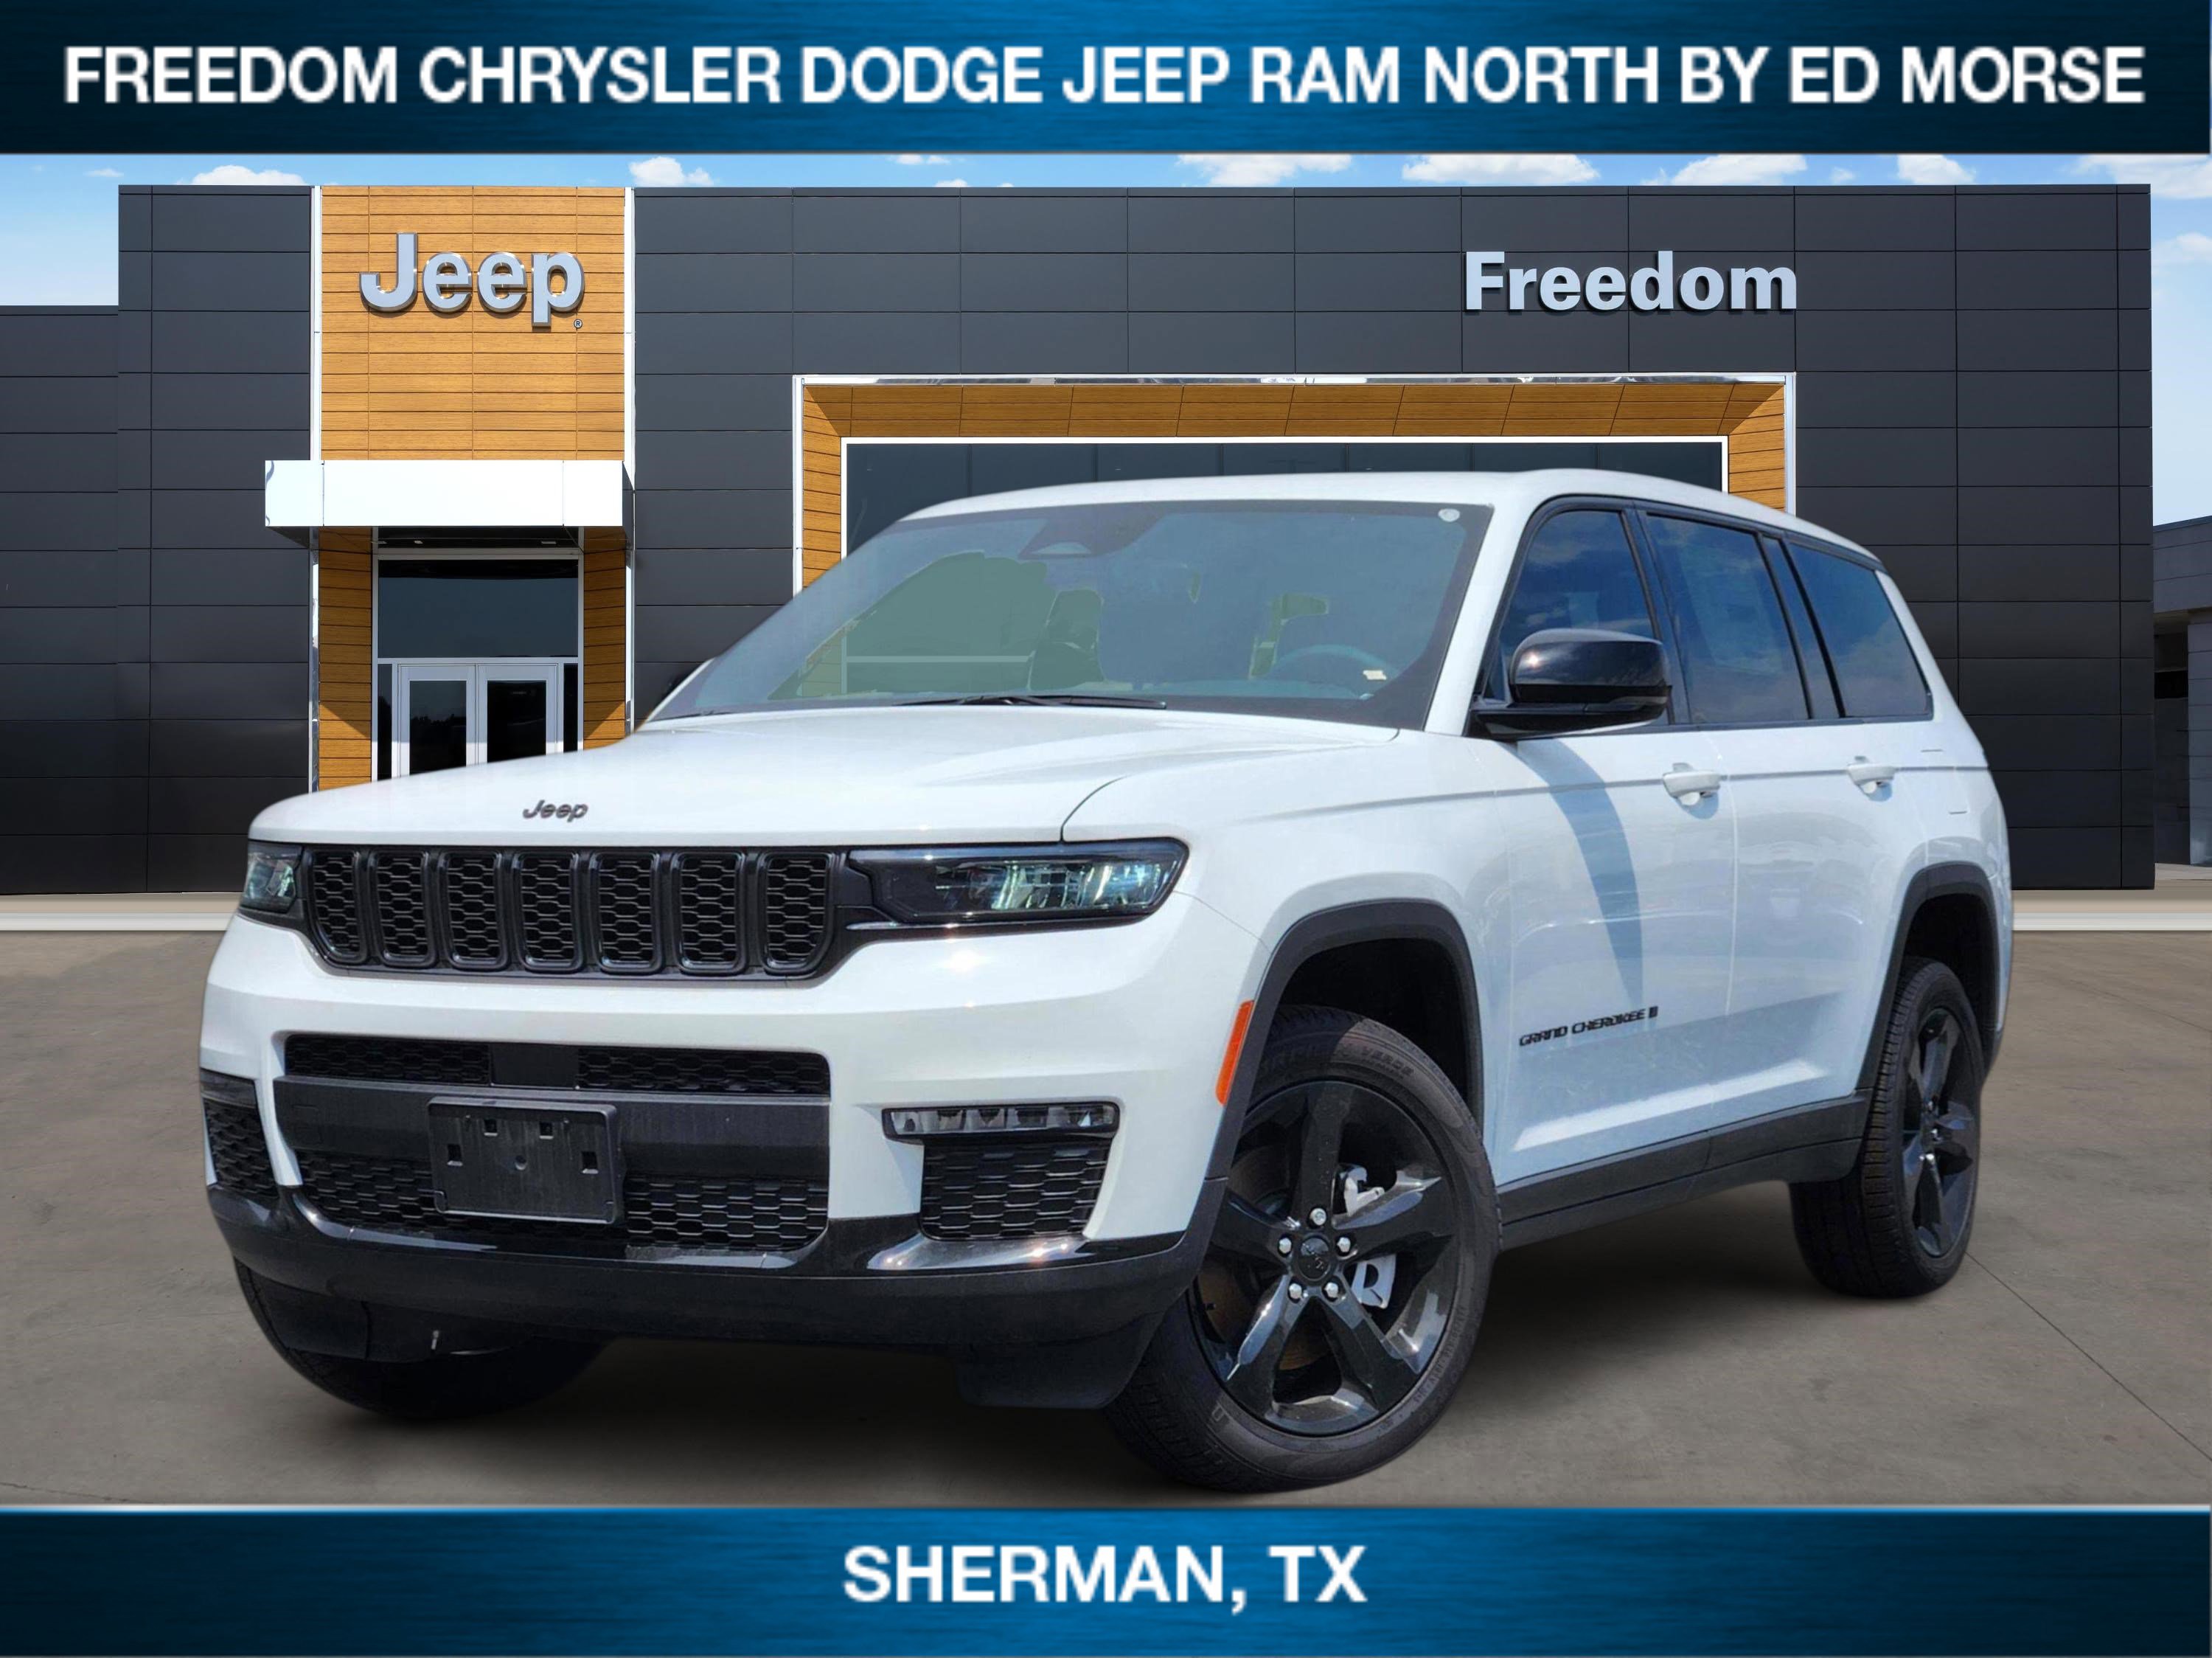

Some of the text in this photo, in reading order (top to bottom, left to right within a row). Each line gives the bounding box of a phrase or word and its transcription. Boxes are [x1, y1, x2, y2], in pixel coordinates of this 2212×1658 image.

[359, 232, 585, 329] Jeep
[1465, 250, 1797, 311] Freedom
[522, 799, 588, 822] Jeep
[1519, 1025, 1568, 1047] GRAND
[1571, 1008, 1646, 1035] CHEROKEE
